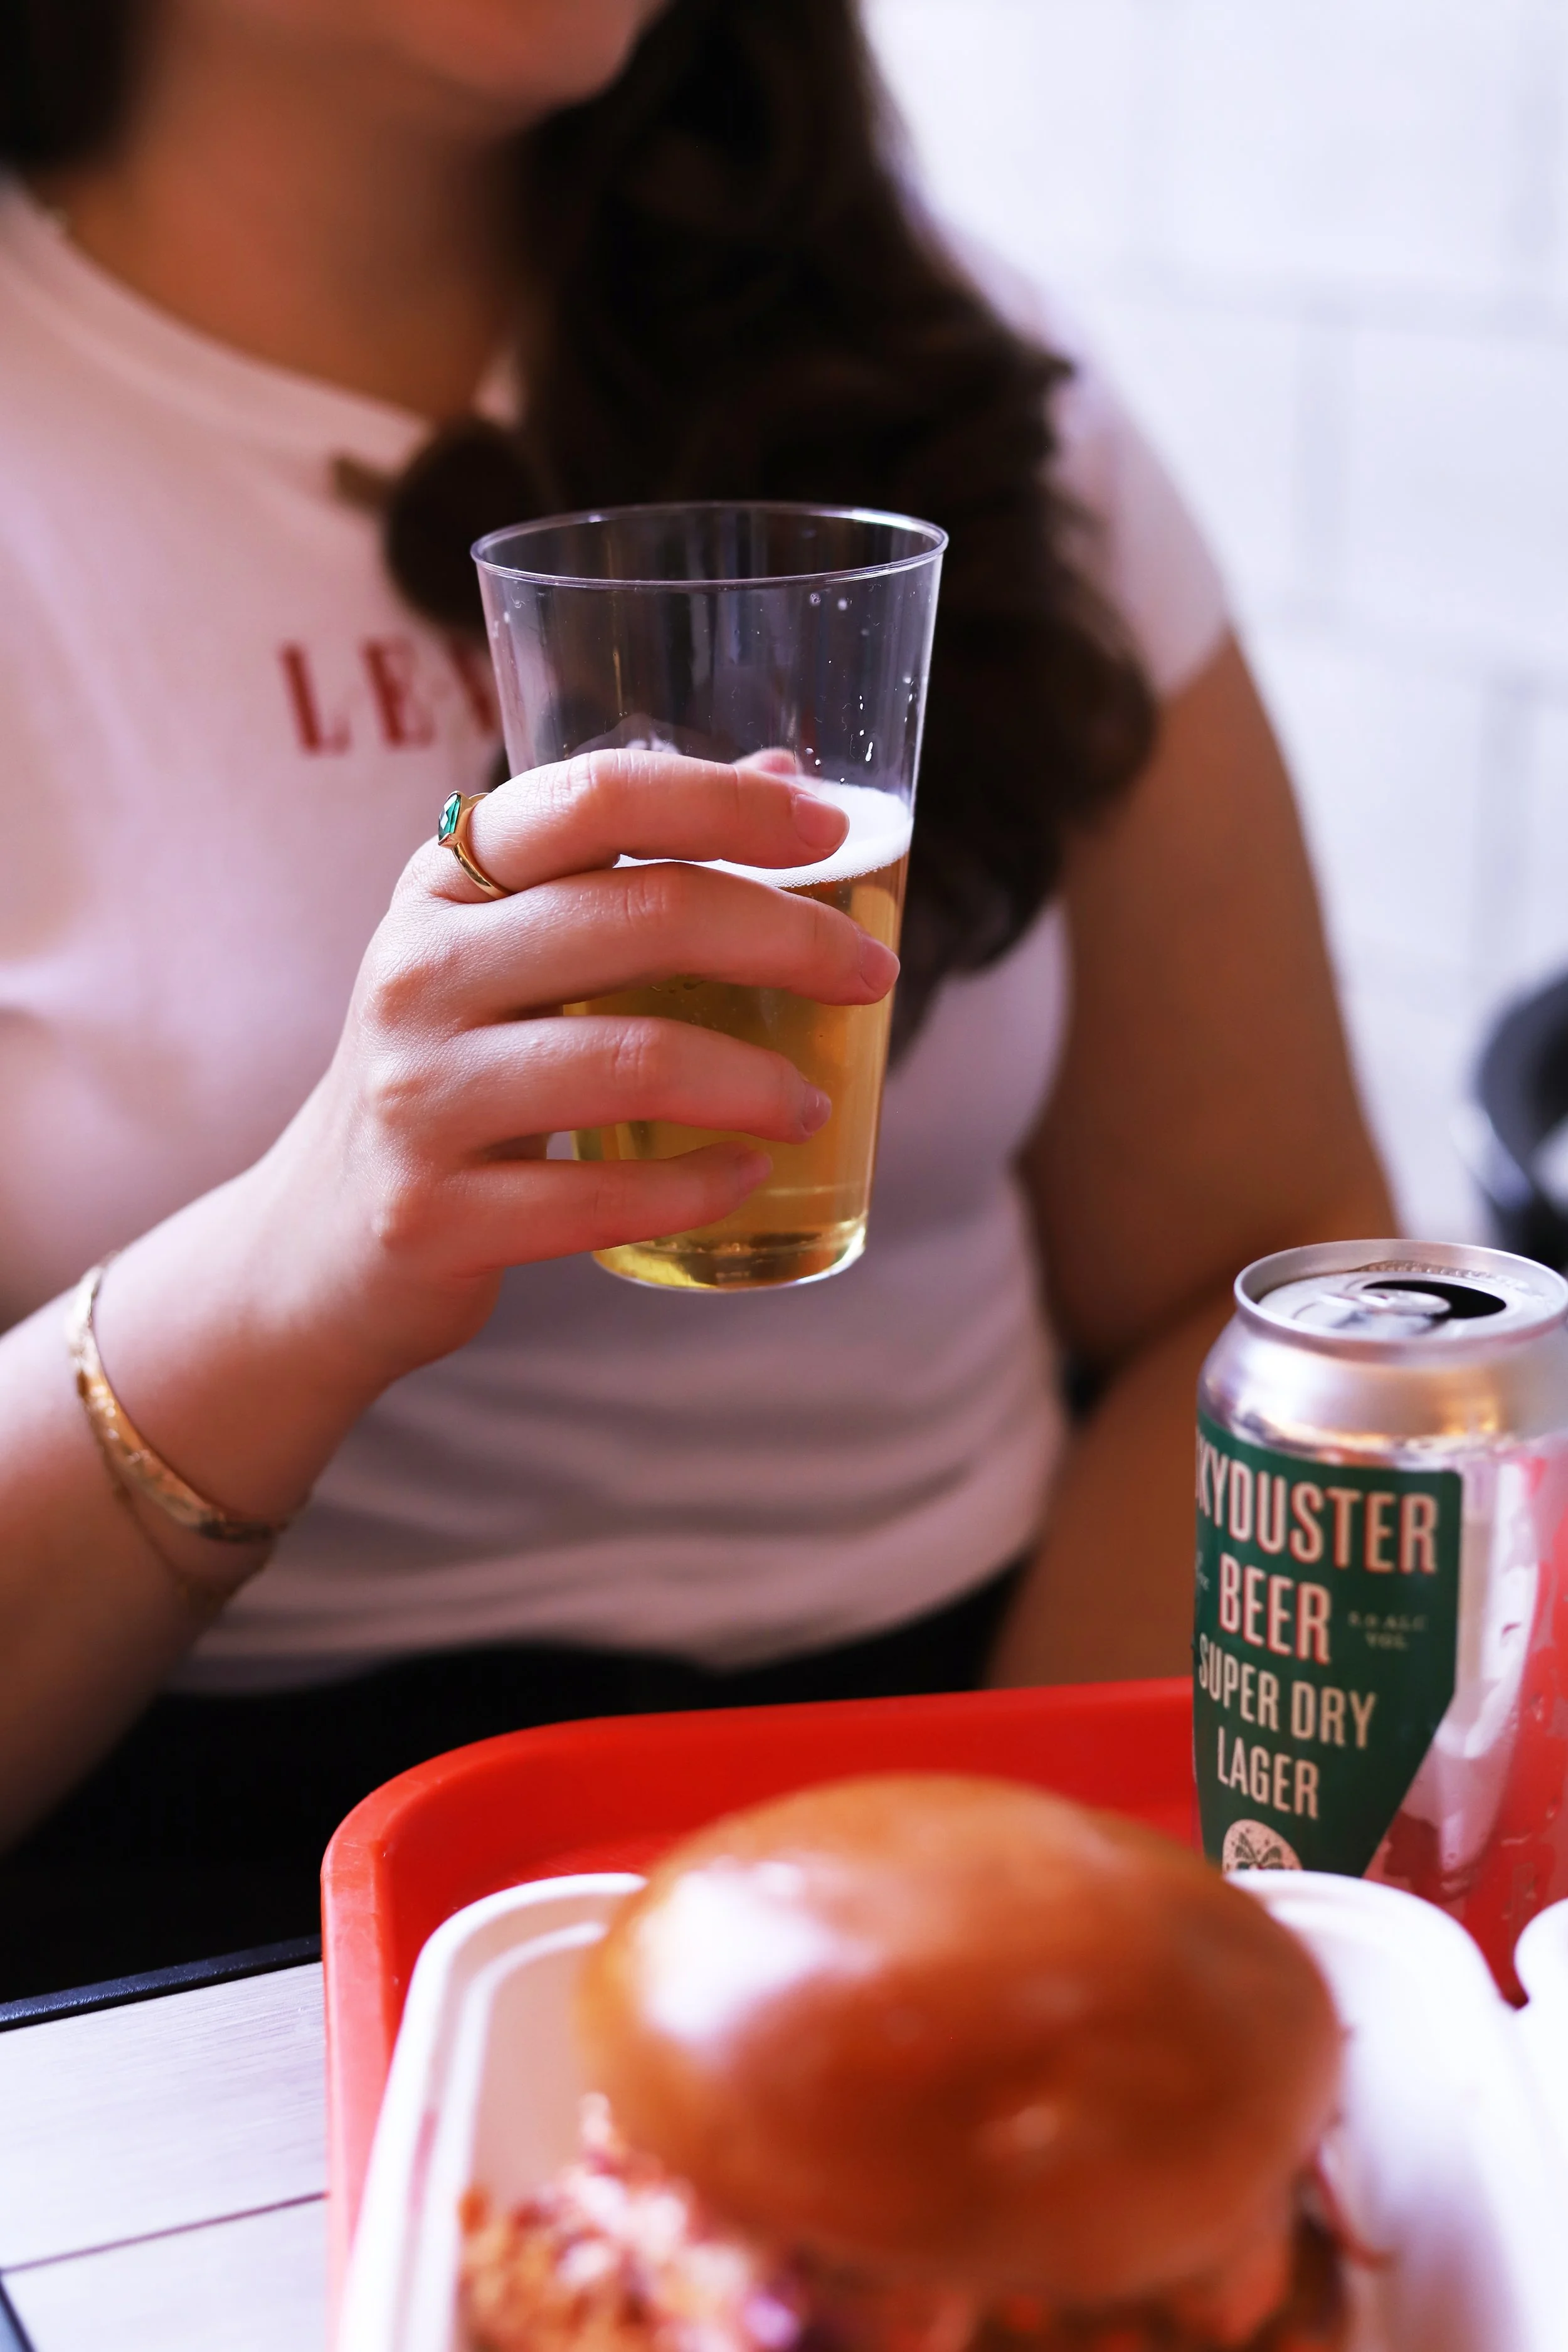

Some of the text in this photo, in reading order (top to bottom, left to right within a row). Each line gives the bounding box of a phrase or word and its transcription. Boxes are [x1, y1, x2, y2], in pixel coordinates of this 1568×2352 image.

[1219, 1552, 1331, 1666] BEER
[1199, 1633, 1376, 1750] SUPER DRY
[1217, 1726, 1319, 1820] LAGER
